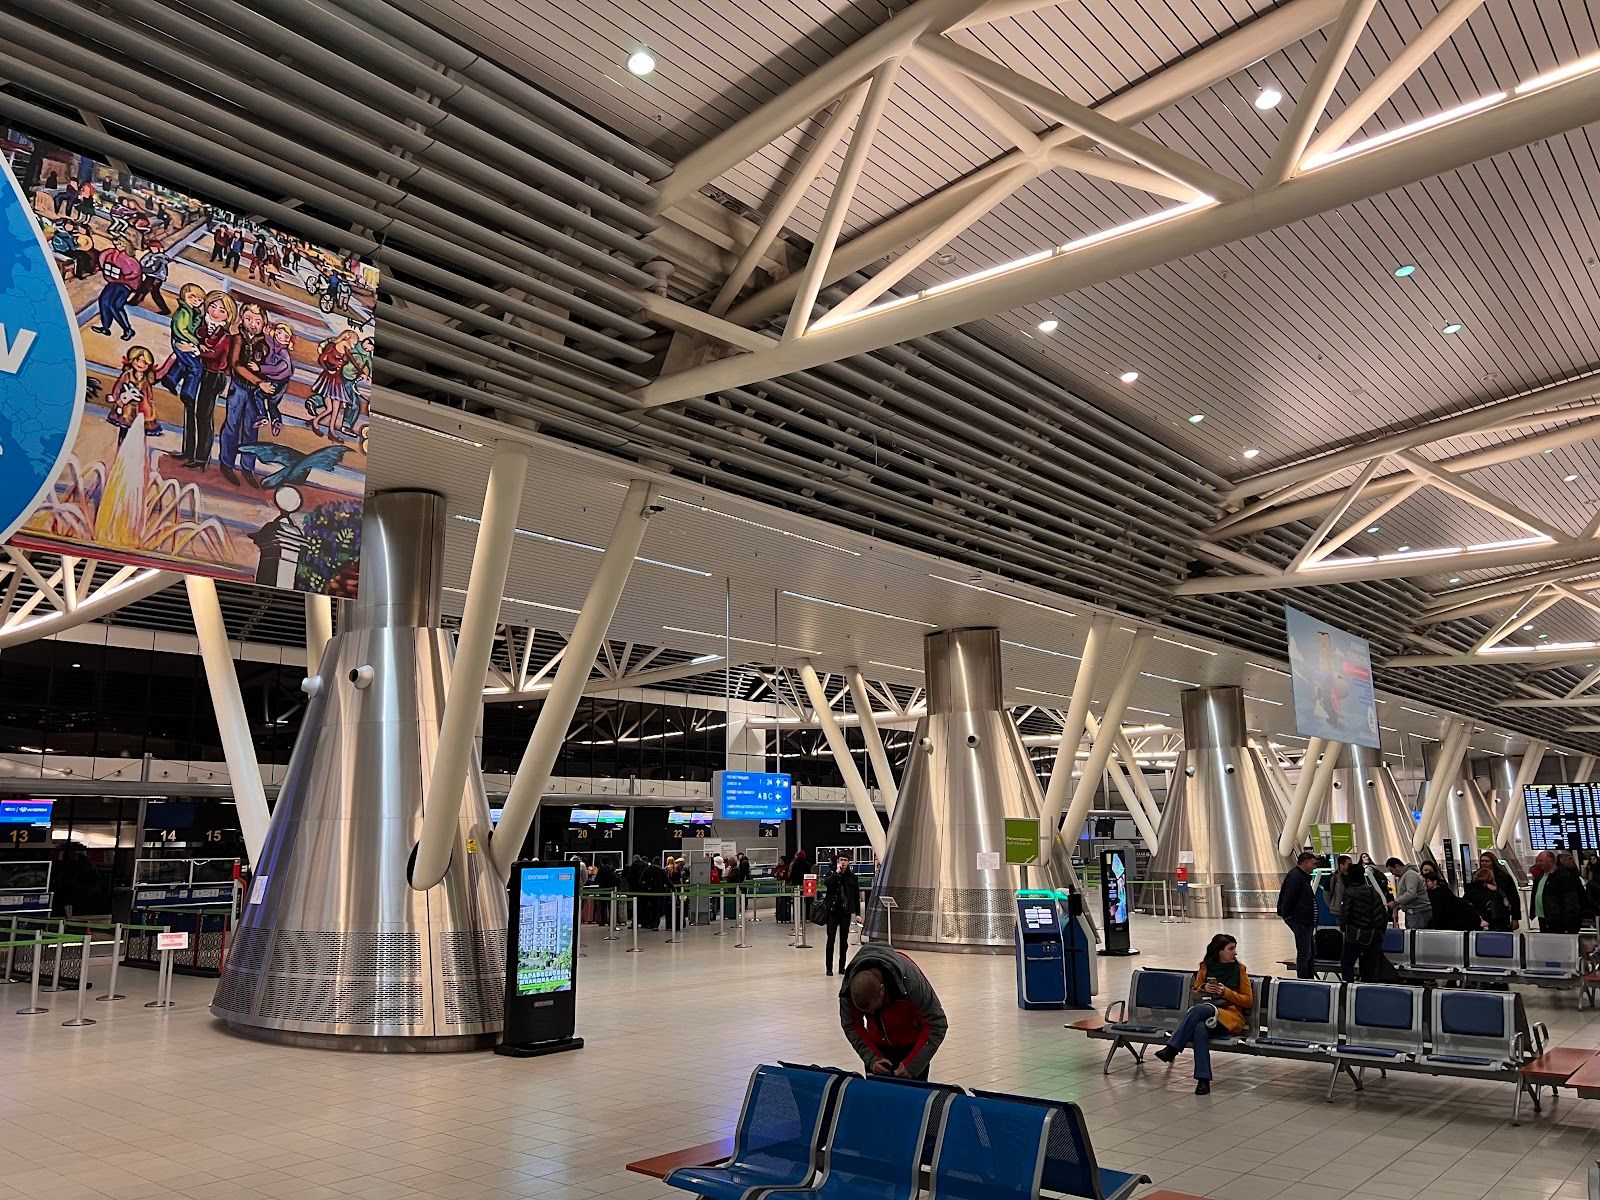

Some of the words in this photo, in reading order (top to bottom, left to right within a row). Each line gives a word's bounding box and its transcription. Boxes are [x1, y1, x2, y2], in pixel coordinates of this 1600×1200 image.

[10, 830, 28, 842] 13
[160, 830, 176, 842] 14
[206, 830, 222, 842] 15
[578, 830, 588, 838] 20
[604, 830, 612, 838] 21
[674, 830, 682, 838] 22
[696, 830, 704, 838] 23
